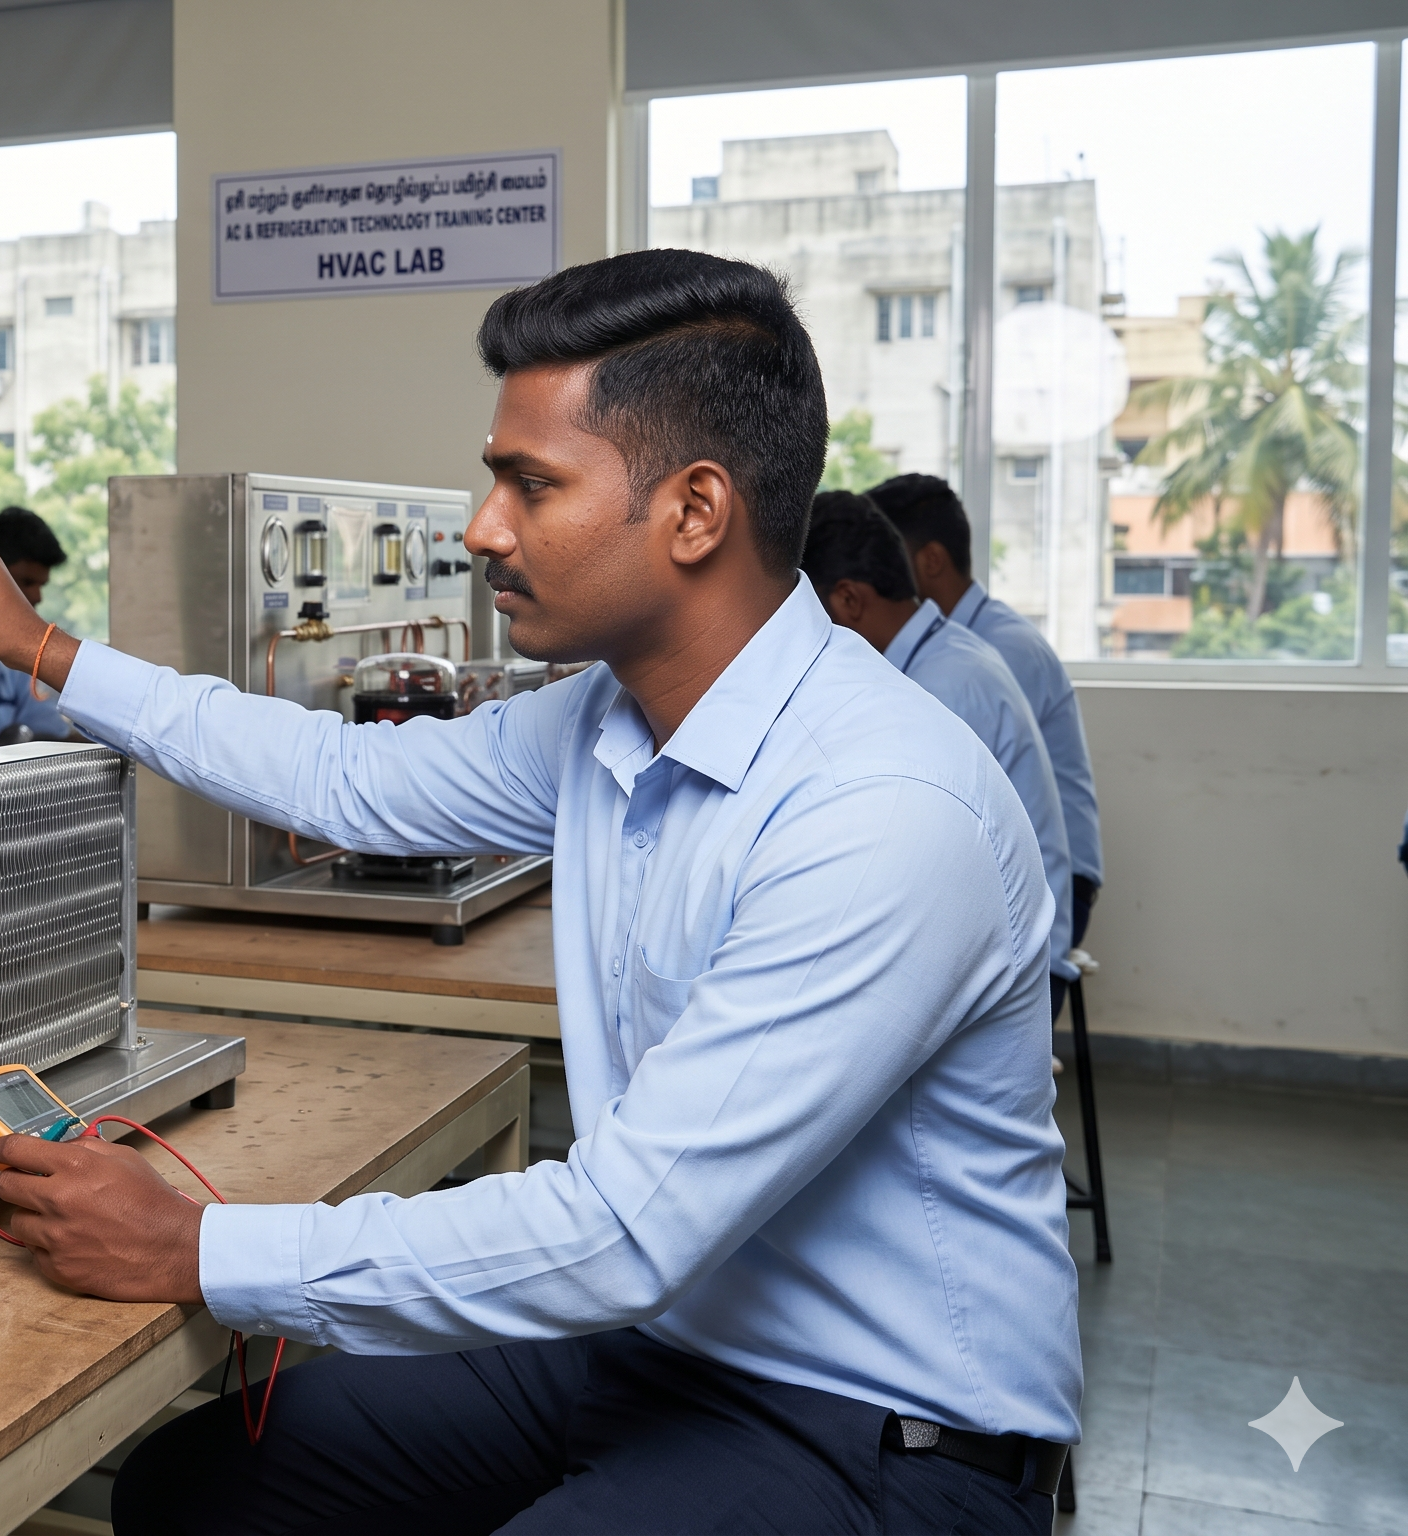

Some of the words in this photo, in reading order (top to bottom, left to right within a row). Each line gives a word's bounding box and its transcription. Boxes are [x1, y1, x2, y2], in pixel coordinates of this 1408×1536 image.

[226, 223, 242, 242] AC
[244, 222, 254, 241] &
[256, 217, 348, 240] REFRIGERATION
[350, 211, 432, 234] TECHNOLOGY
[434, 208, 493, 229] TRAINING
[496, 204, 547, 225] CENTER
[318, 250, 387, 280] HVAC
[394, 247, 445, 276] LAB
